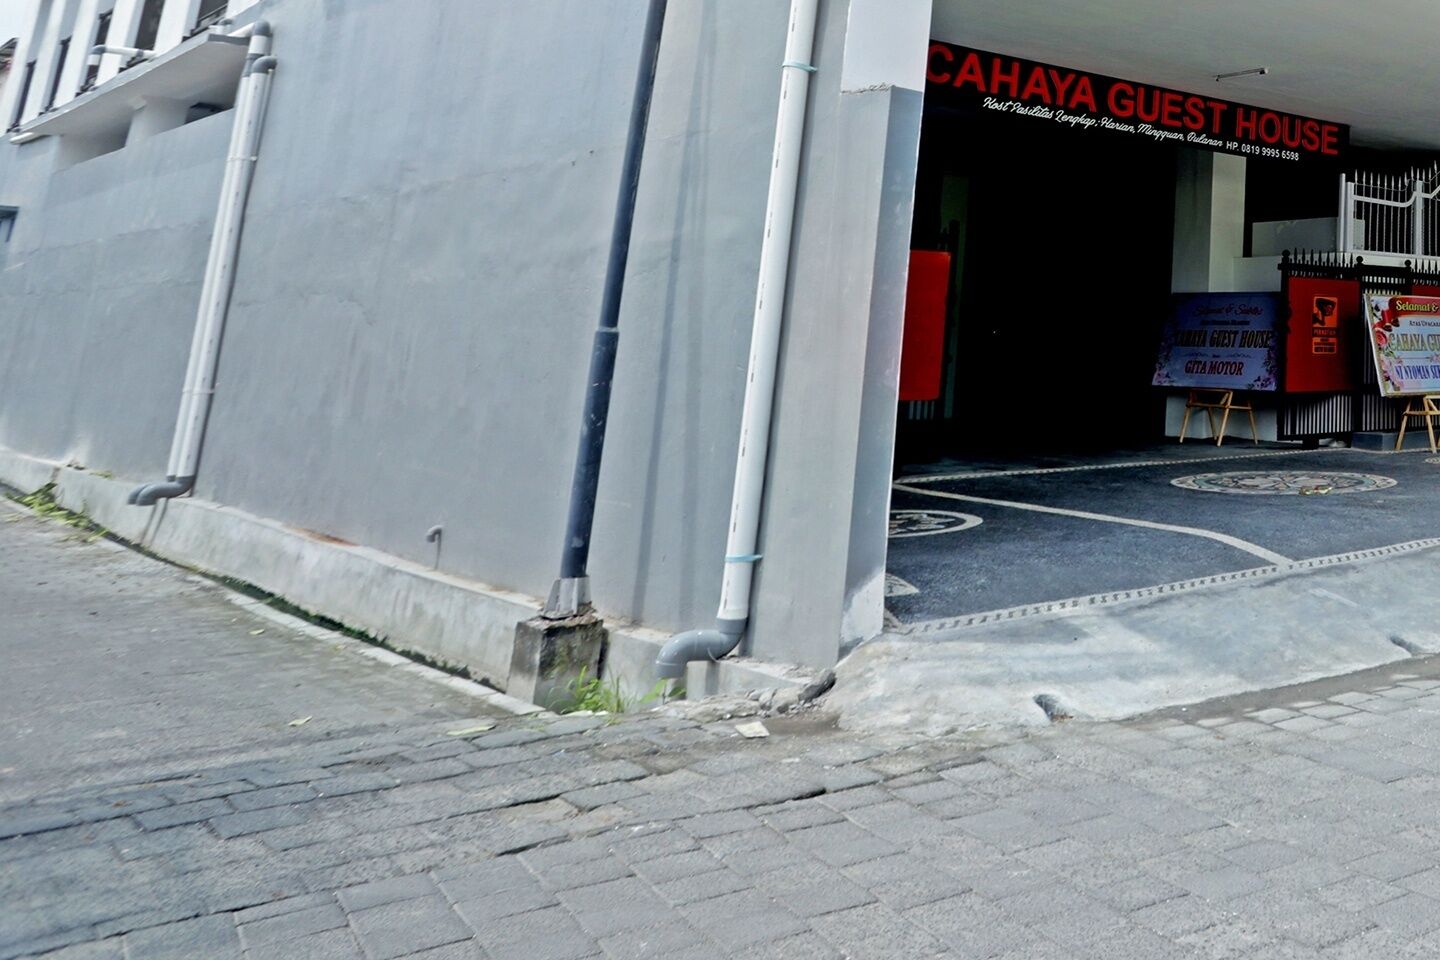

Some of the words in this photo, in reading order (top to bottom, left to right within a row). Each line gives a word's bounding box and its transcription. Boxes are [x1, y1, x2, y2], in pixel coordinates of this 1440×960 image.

[926, 45, 1097, 113] CAHAYA
[1107, 82, 1227, 134] GUEST
[1235, 107, 1339, 156] HOUSE
[983, 96, 1013, 111] Kost
[1225, 140, 1239, 152] HP.
[1241, 143, 1260, 155] 0819
[1261, 146, 1280, 159] 9995
[1281, 150, 1299, 161] 6598
[1396, 300, 1430, 312] Selamat
[1432, 302, 1440, 312] &
[1210, 329, 1239, 348] GUEST
[1239, 329, 1272, 348] HOUSE
[1389, 332, 1425, 351] CAHAYA
[1185, 360, 1207, 375] GITA
[1208, 360, 1244, 376] MOTOR
